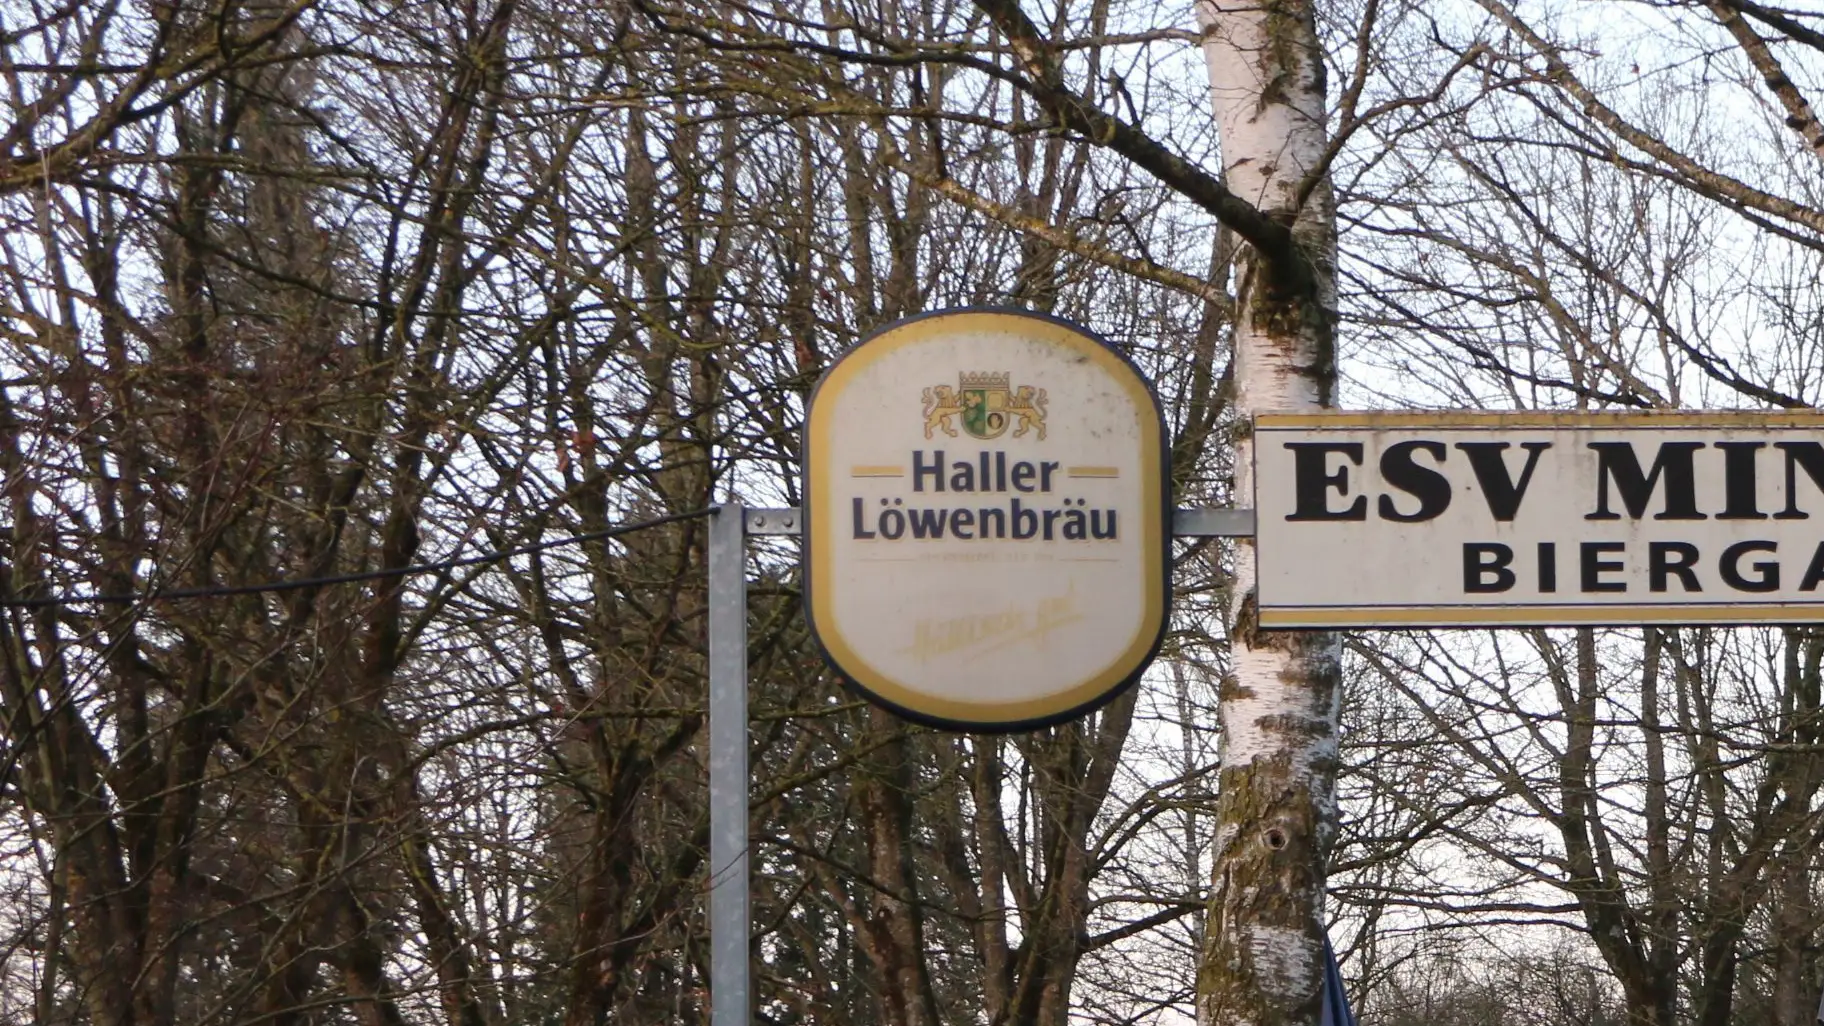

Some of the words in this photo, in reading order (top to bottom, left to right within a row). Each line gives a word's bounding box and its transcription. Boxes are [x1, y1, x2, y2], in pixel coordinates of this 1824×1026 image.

[913, 450, 1059, 493] Haller
[1283, 440, 1553, 523] ESV
[852, 497, 1117, 541] Löwenbräu
